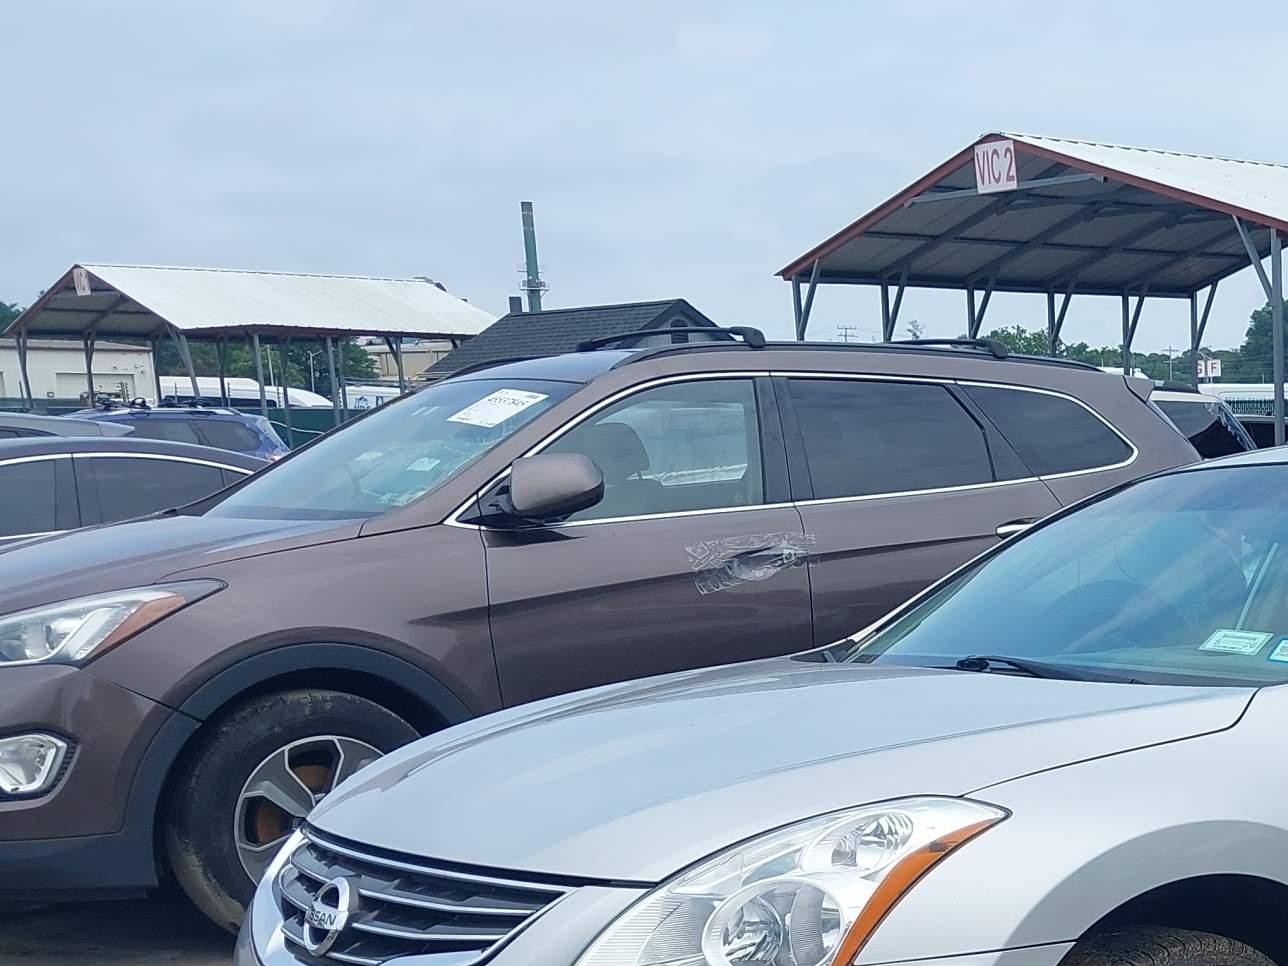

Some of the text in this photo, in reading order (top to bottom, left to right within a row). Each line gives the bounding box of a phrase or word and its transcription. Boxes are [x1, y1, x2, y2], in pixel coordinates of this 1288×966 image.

[976, 147, 1015, 186] VIC 2
[1211, 362, 1217, 374] F
